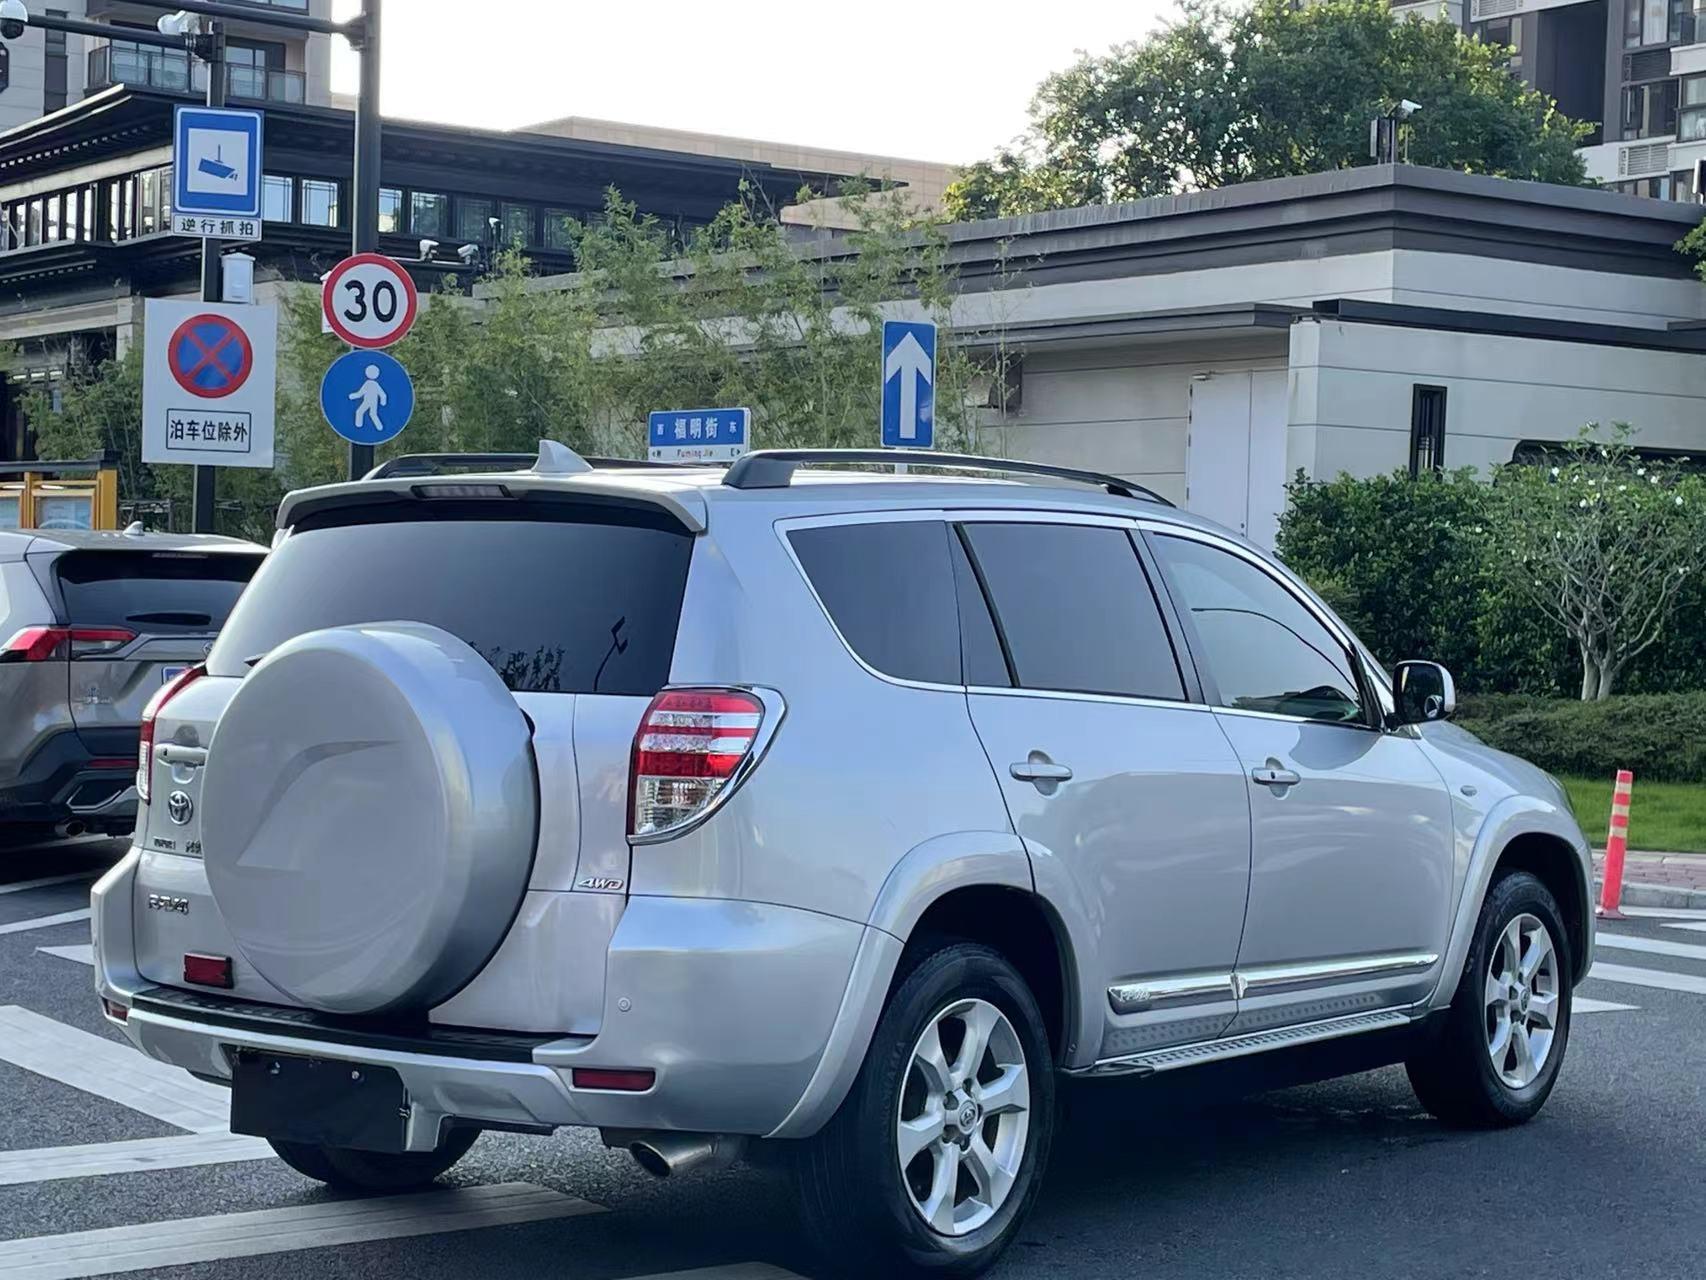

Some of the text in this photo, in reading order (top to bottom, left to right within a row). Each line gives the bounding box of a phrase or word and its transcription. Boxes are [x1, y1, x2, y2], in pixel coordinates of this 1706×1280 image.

[181, 218, 254, 236] 逆行抓拍
[344, 280, 397, 323] 30
[170, 419, 248, 443] 泊车位除外
[674, 417, 718, 439] 福明街
[578, 877, 624, 890] 4WD
